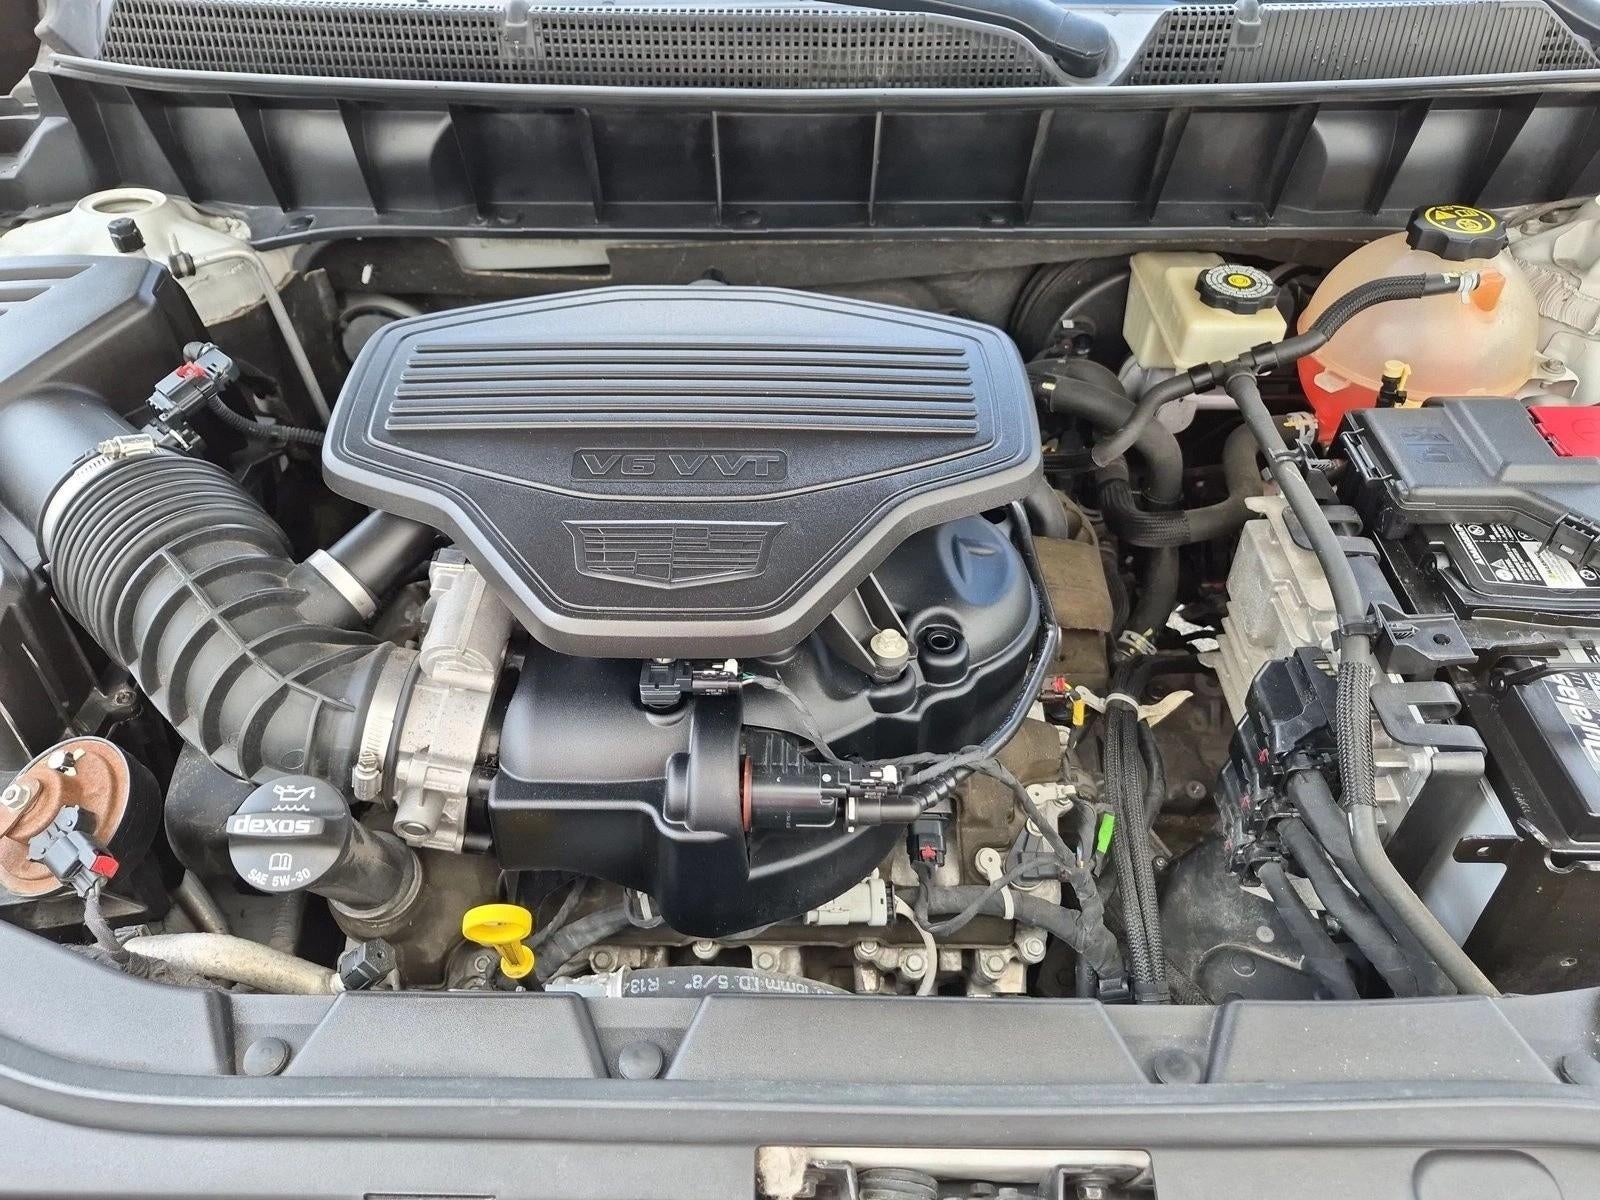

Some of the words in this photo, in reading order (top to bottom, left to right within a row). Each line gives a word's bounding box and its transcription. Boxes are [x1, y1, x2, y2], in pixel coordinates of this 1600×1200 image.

[581, 454, 656, 475] V6
[668, 454, 780, 476] VVT
[1550, 673, 1600, 762] Duralas
[233, 814, 312, 834] dexos
[247, 868, 269, 887] SAE
[271, 867, 312, 888] 5W-30
